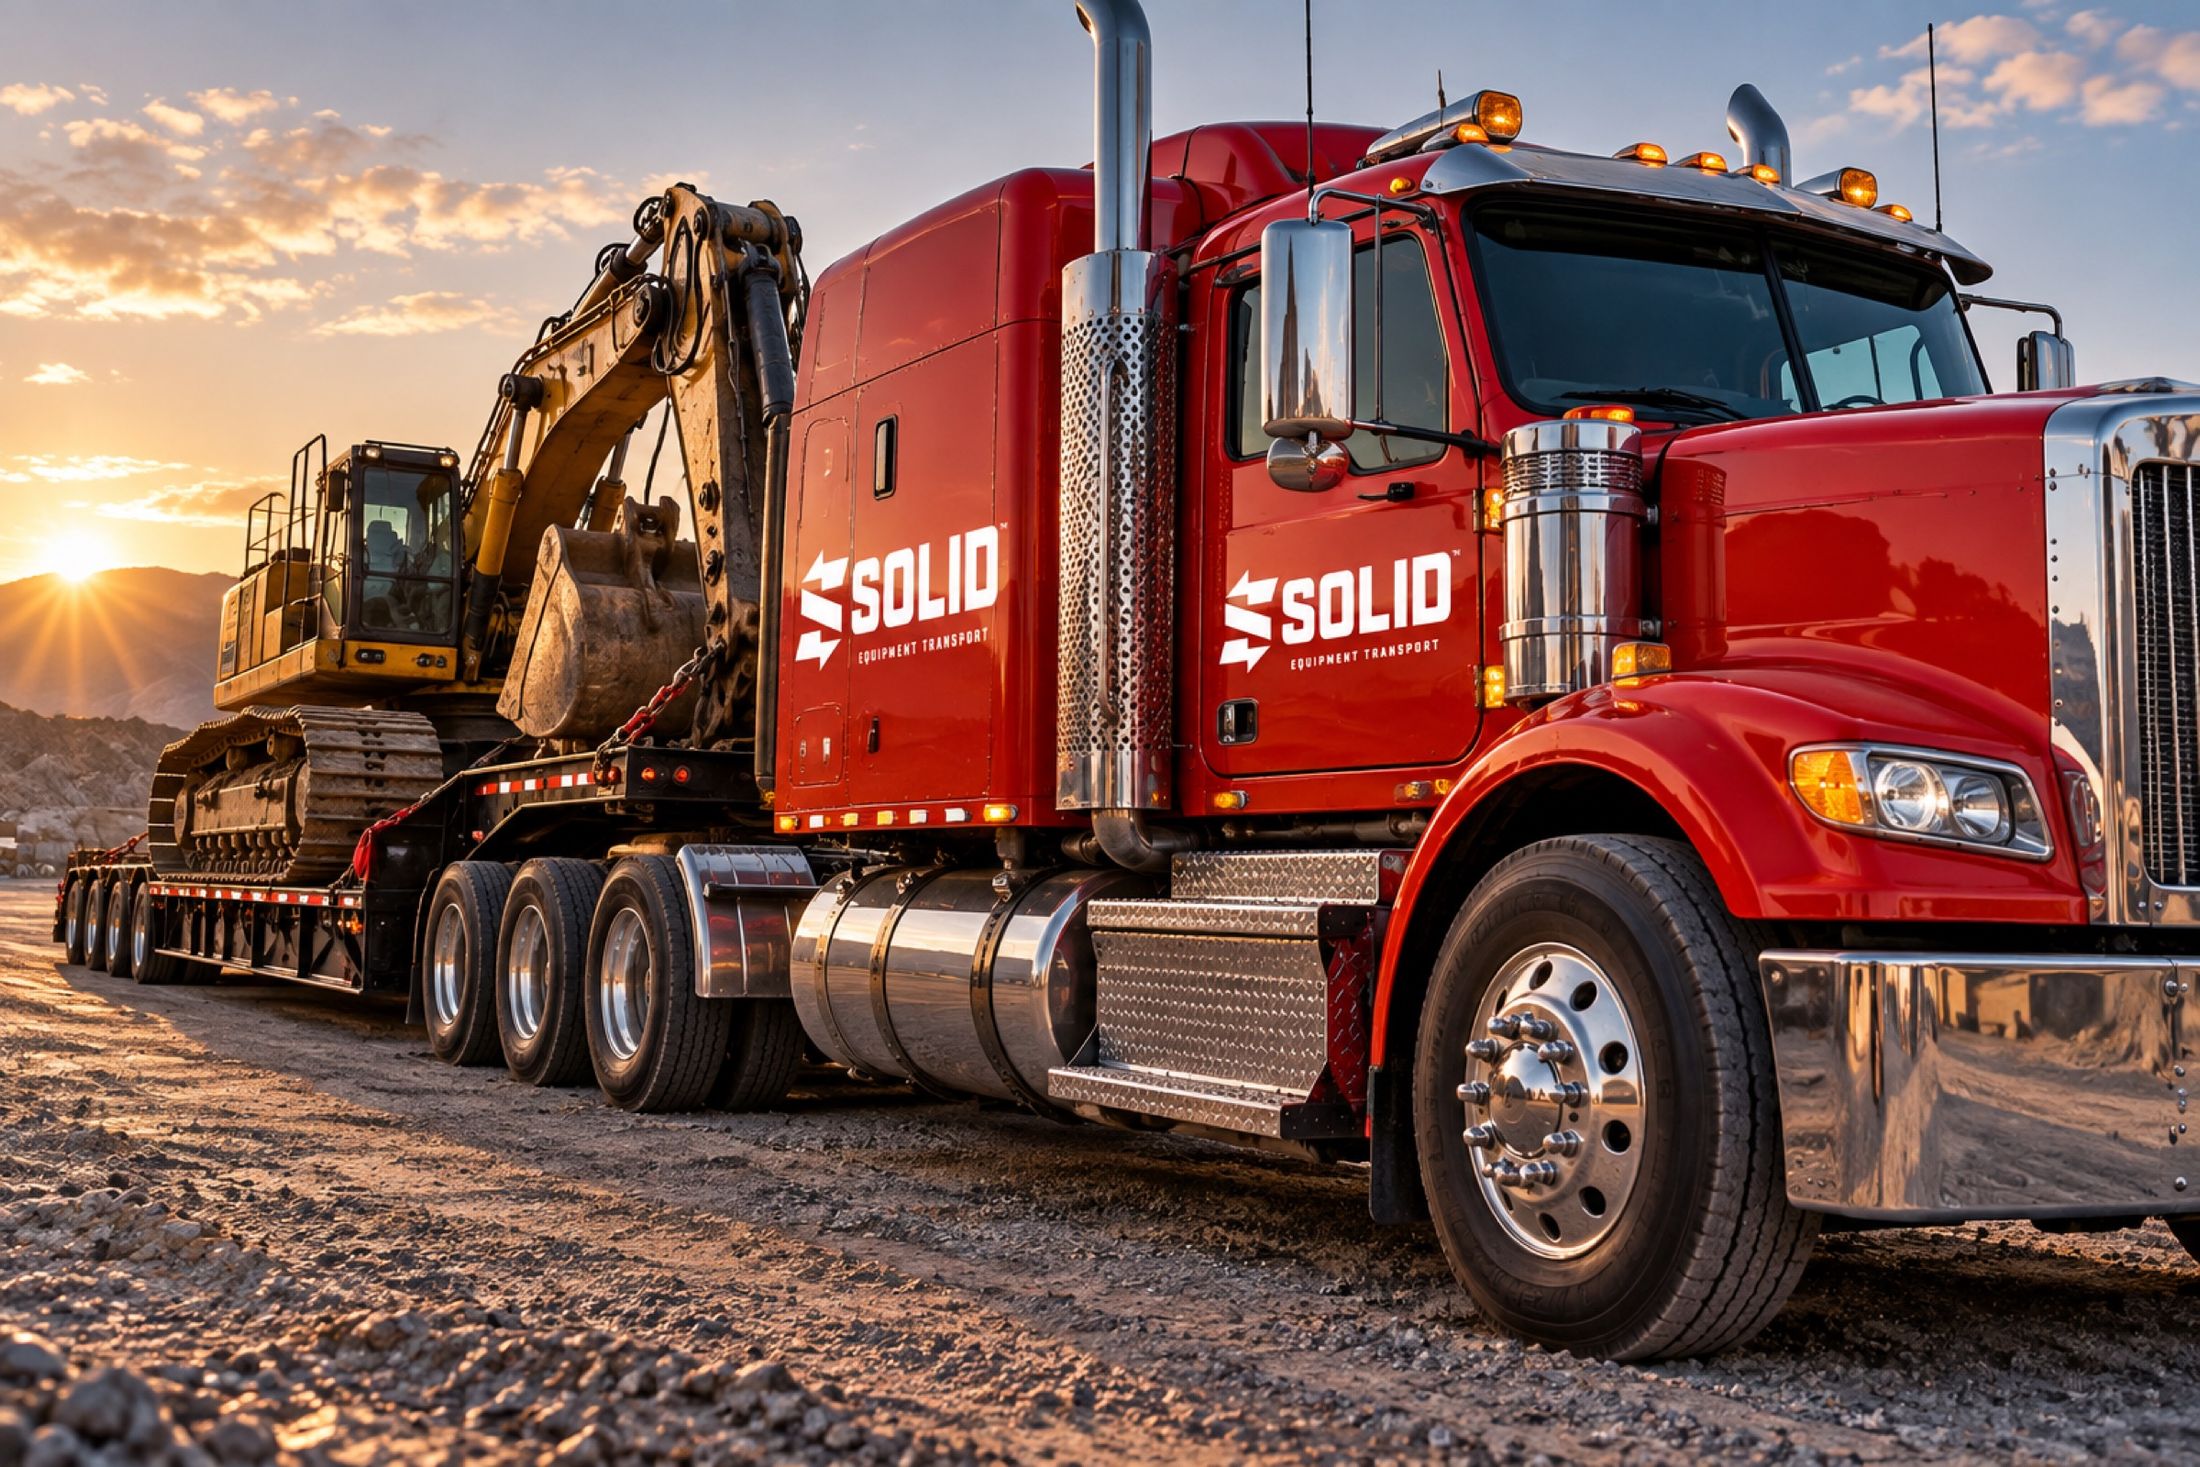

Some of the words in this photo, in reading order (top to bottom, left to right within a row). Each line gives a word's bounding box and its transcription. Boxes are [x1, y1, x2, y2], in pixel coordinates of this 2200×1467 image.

[851, 525, 999, 635] SOLID
[1281, 551, 1451, 645] SOLID
[858, 641, 917, 665] EQUIPMENT
[922, 627, 988, 652] TRANSPORT
[1290, 651, 1358, 671] EQUIPMENT
[1364, 639, 1439, 659] TRANSPORT
